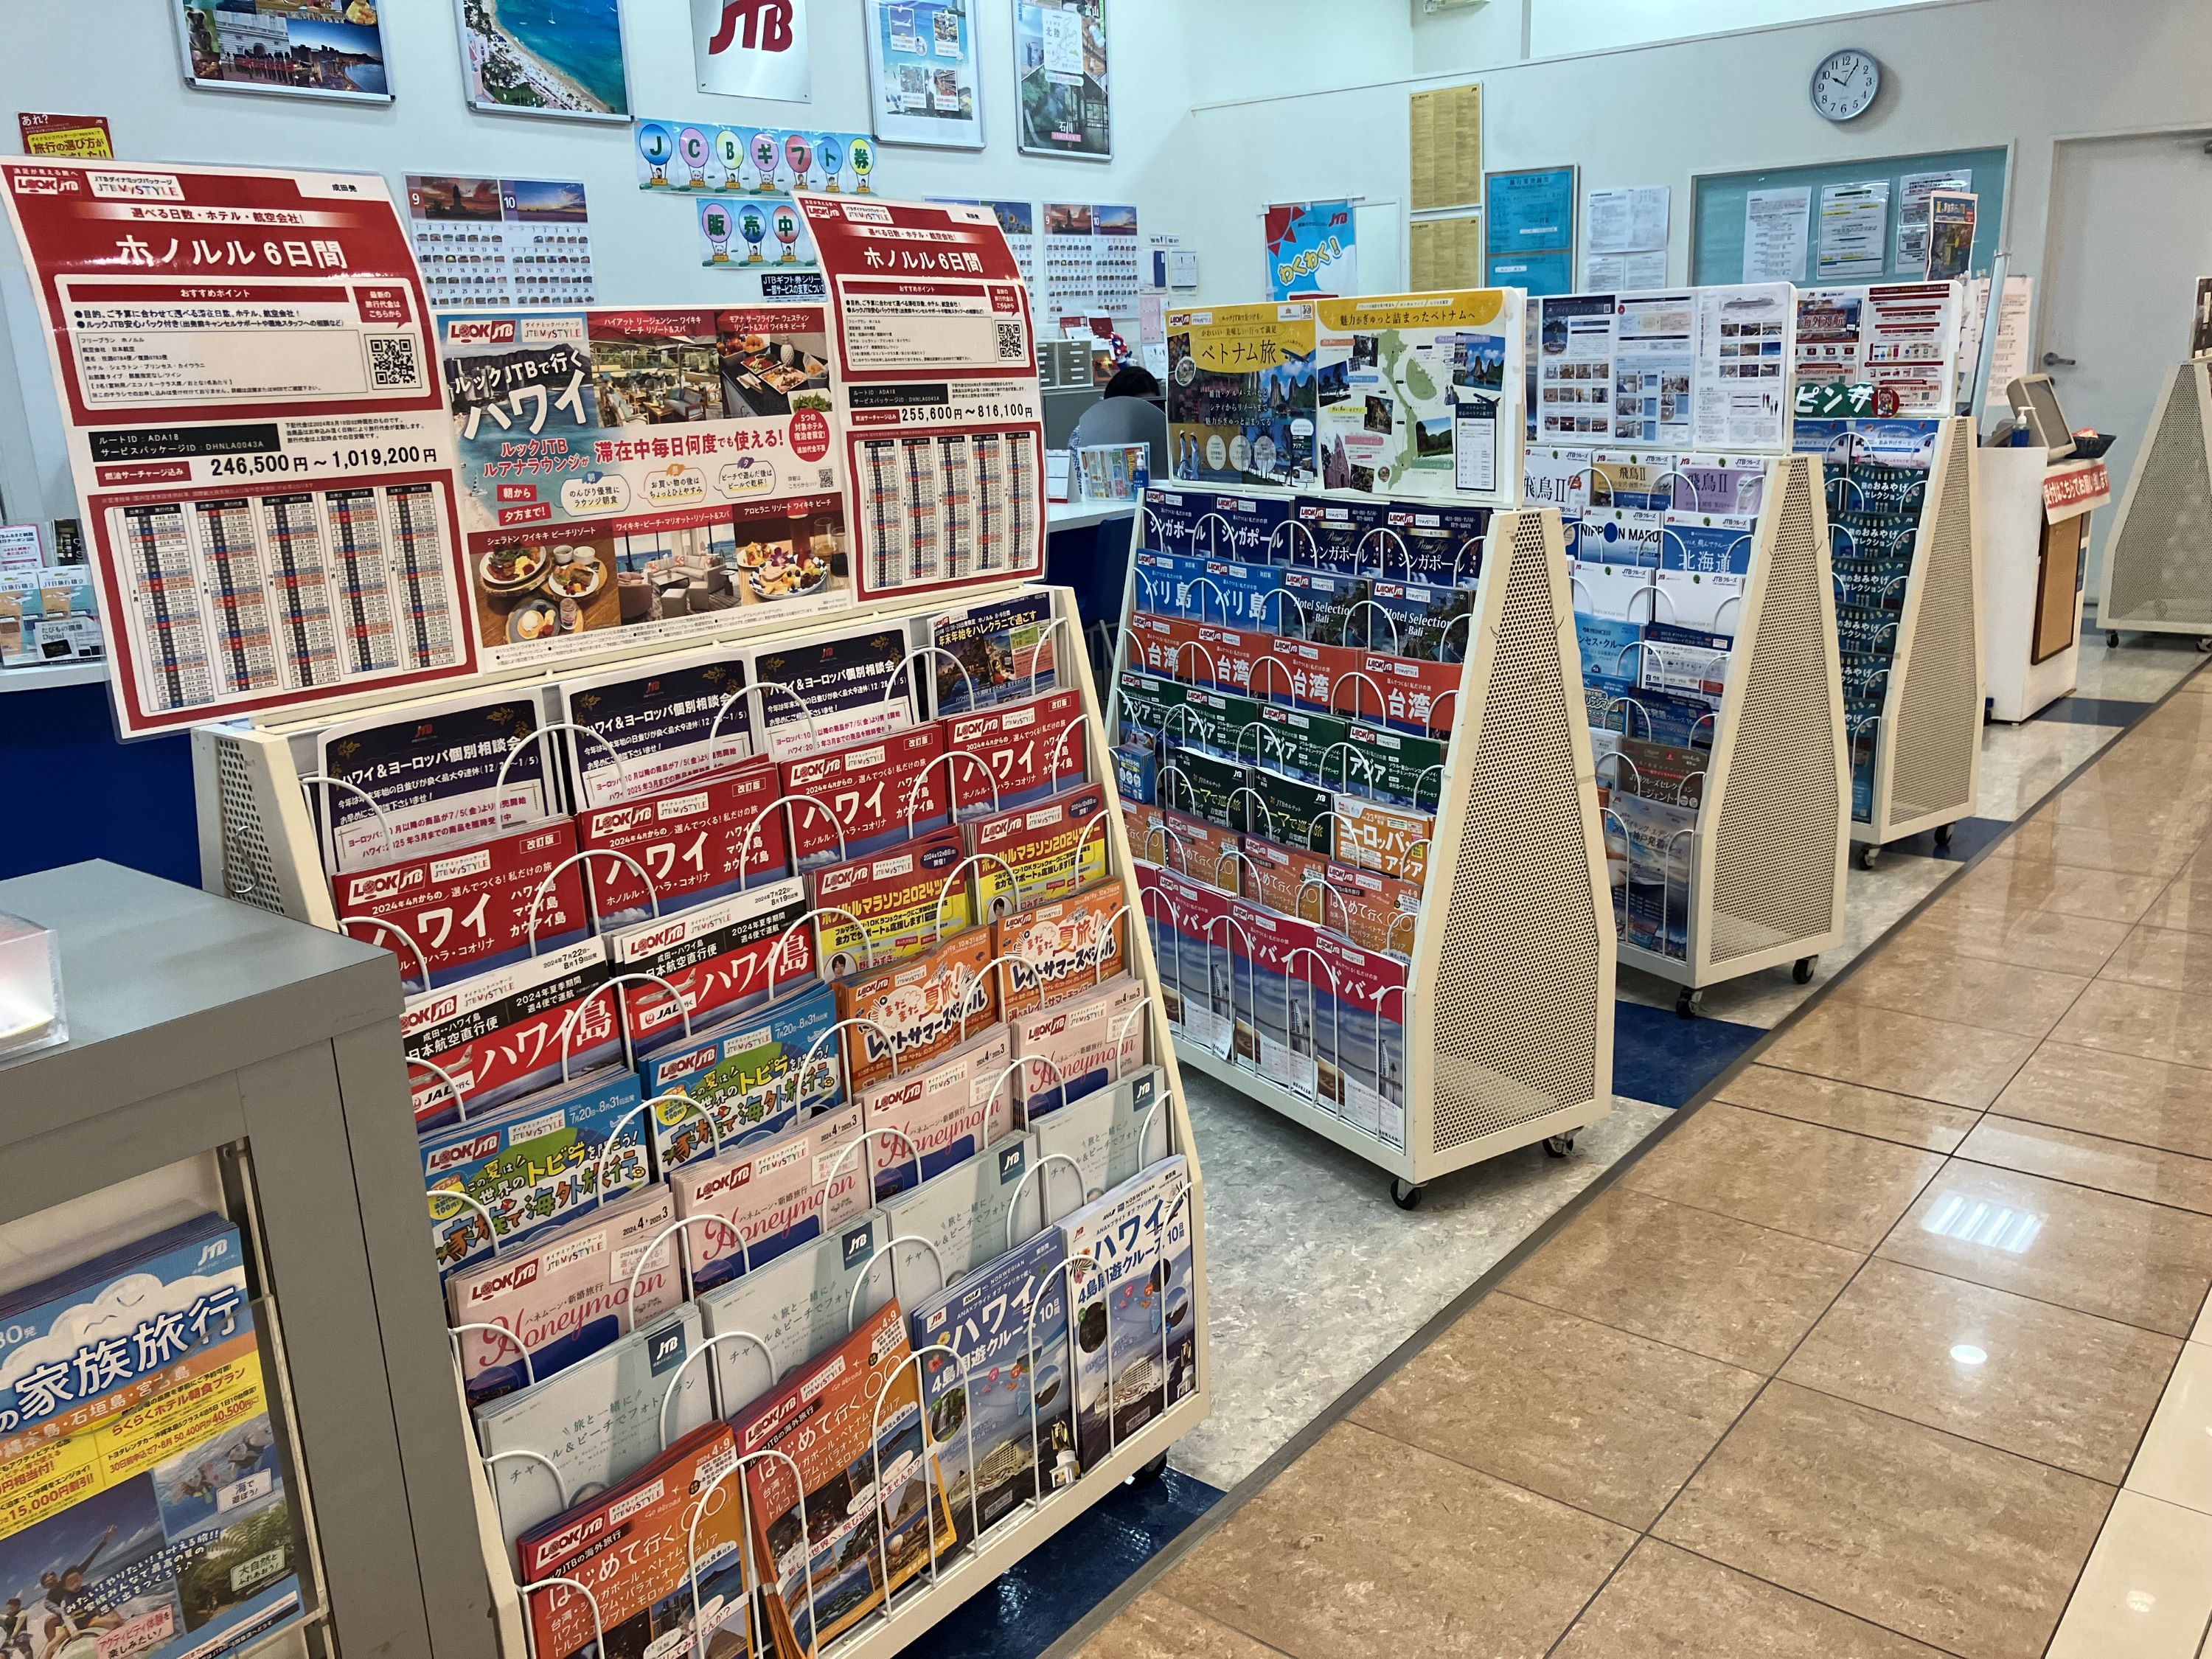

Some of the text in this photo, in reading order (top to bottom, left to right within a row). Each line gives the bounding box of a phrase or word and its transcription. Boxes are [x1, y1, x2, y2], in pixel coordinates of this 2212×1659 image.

[1085, 5, 1099, 17] 富山
[709, 0, 793, 55] JTB
[1046, 27, 1060, 38] 北陸
[1831, 60, 1838, 70] 11
[1841, 56, 1850, 66] 12
[1863, 66, 1868, 75] 2
[1822, 71, 1830, 80] 10
[1866, 77, 1871, 86] 3
[1818, 83, 1824, 91] 9
[1862, 91, 1867, 99] 4
[1821, 95, 1827, 103] 8
[1831, 102, 1836, 112] 7
[1840, 103, 1846, 113] 6
[1852, 100, 1858, 109] 5
[21, 114, 49, 126] あれ?
[1059, 122, 1073, 133] 石川
[331, 183, 357, 192] 成田発
[411, 193, 420, 206] 9
[504, 195, 515, 208] 10
[1093, 216, 1100, 226] 10
[1329, 212, 1347, 227] JTB
[115, 234, 347, 269] ホノルル 6日間
[864, 247, 983, 273] ホノルル 6日間
[1279, 237, 1340, 283] わくわく!
[181, 289, 250, 298] おすすめポイント
[366, 300, 400, 308] 旅行代金は
[369, 310, 402, 319] こちらから
[492, 324, 514, 339] JTB
[647, 325, 685, 333] リゾート&スパ
[1201, 341, 1276, 365] ベトナム旅
[455, 349, 582, 394] ルックJTBで行く
[464, 369, 586, 439] ハワイ
[795, 422, 823, 431] 対象ホテル
[147, 434, 178, 442] ADA18
[501, 439, 568, 457] ルックJTB
[595, 429, 784, 463] 滞在中毎日何度でも使える!
[484, 456, 588, 477] ルアナラウンジが
[721, 470, 772, 481] ビーチで遊んだ後は
[504, 487, 530, 498] 朝から
[569, 487, 619, 498] のんびり優雅に
[650, 487, 703, 498] ちょっとひとやすみ
[652, 478, 699, 488] お買い物の後は
[728, 479, 767, 489] ビールで乾杯!
[574, 495, 618, 504] ラウンジ朝食
[505, 507, 546, 522] 夕方まで!
[487, 526, 595, 546] シェラトン ワイキキ ビーチリゾート
[1150, 516, 1206, 540] シンガポール
[1222, 527, 1284, 548] シンガポール
[1310, 546, 1368, 563] シンガポール
[1398, 552, 1464, 572] シンガポール
[1679, 552, 1731, 572] 北海道
[1145, 581, 1192, 607] バリ島
[1216, 591, 1267, 619] バリ島
[1294, 597, 1356, 616] Hotel Selection
[1385, 608, 1451, 627] Hotel Selection
[939, 610, 1037, 646] 年末年始をハレクラニで過ごす
[1148, 643, 1178, 669] 台湾
[1217, 654, 1250, 685] 台湾
[1294, 669, 1329, 701] 台湾
[1052, 699, 1067, 708] 改訂版
[1388, 689, 1430, 723] 台湾
[414, 724, 433, 737] JTB
[1188, 717, 1215, 739] アジア
[966, 736, 1008, 751] 2024年4月からの
[1265, 734, 1296, 759] アジア
[963, 740, 1035, 782] ハワイ
[1350, 756, 1385, 784] アジア
[737, 782, 760, 793] 改訂版
[807, 779, 853, 795] 2024年4月からの
[802, 782, 884, 830] ハワイ
[674, 806, 758, 833] 選んでつくる! 私だけの旅
[526, 835, 554, 850] 改訂版
[610, 827, 667, 847] 2024年4月からの
[606, 832, 708, 885] ハワイ
[933, 859, 946, 867] 開催!
[1385, 854, 1424, 877] アジア
[451, 863, 552, 898] 選んでつくる! 私だけの旅
[372, 889, 442, 915] 2024年4月からの
[646, 945, 717, 978] 日本航空直行便
[698, 934, 809, 1003] ハワイ島
[516, 976, 582, 1006] 2024年夏季期間
[527, 988, 574, 1014] 週4便で運航
[657, 1005, 679, 1020] JAL
[408, 1016, 499, 1060] 日本航空直行便
[476, 999, 609, 1083] ハワイ島
[1031, 1040, 1135, 1092] Honeymoon
[425, 1085, 451, 1105] JAL
[878, 1099, 1001, 1168] Honeymoon
[468, 1159, 512, 1192] この夏は
[1127, 1184, 1155, 1206] NORWEGIAN
[1093, 1197, 1165, 1273] ハワイ
[991, 1259, 1025, 1283] NORWEGIAN
[525, 1283, 603, 1325] ハネムーン・新婚旅行
[480, 1274, 665, 1366] Honeymoon
[950, 1276, 1036, 1356] ハワイ
[573, 1391, 632, 1431] 旅と一緒に
[232, 1489, 258, 1504] 遊ぼう!
[236, 1481, 254, 1494] 海で
[239, 1554, 277, 1576] 大自然と
